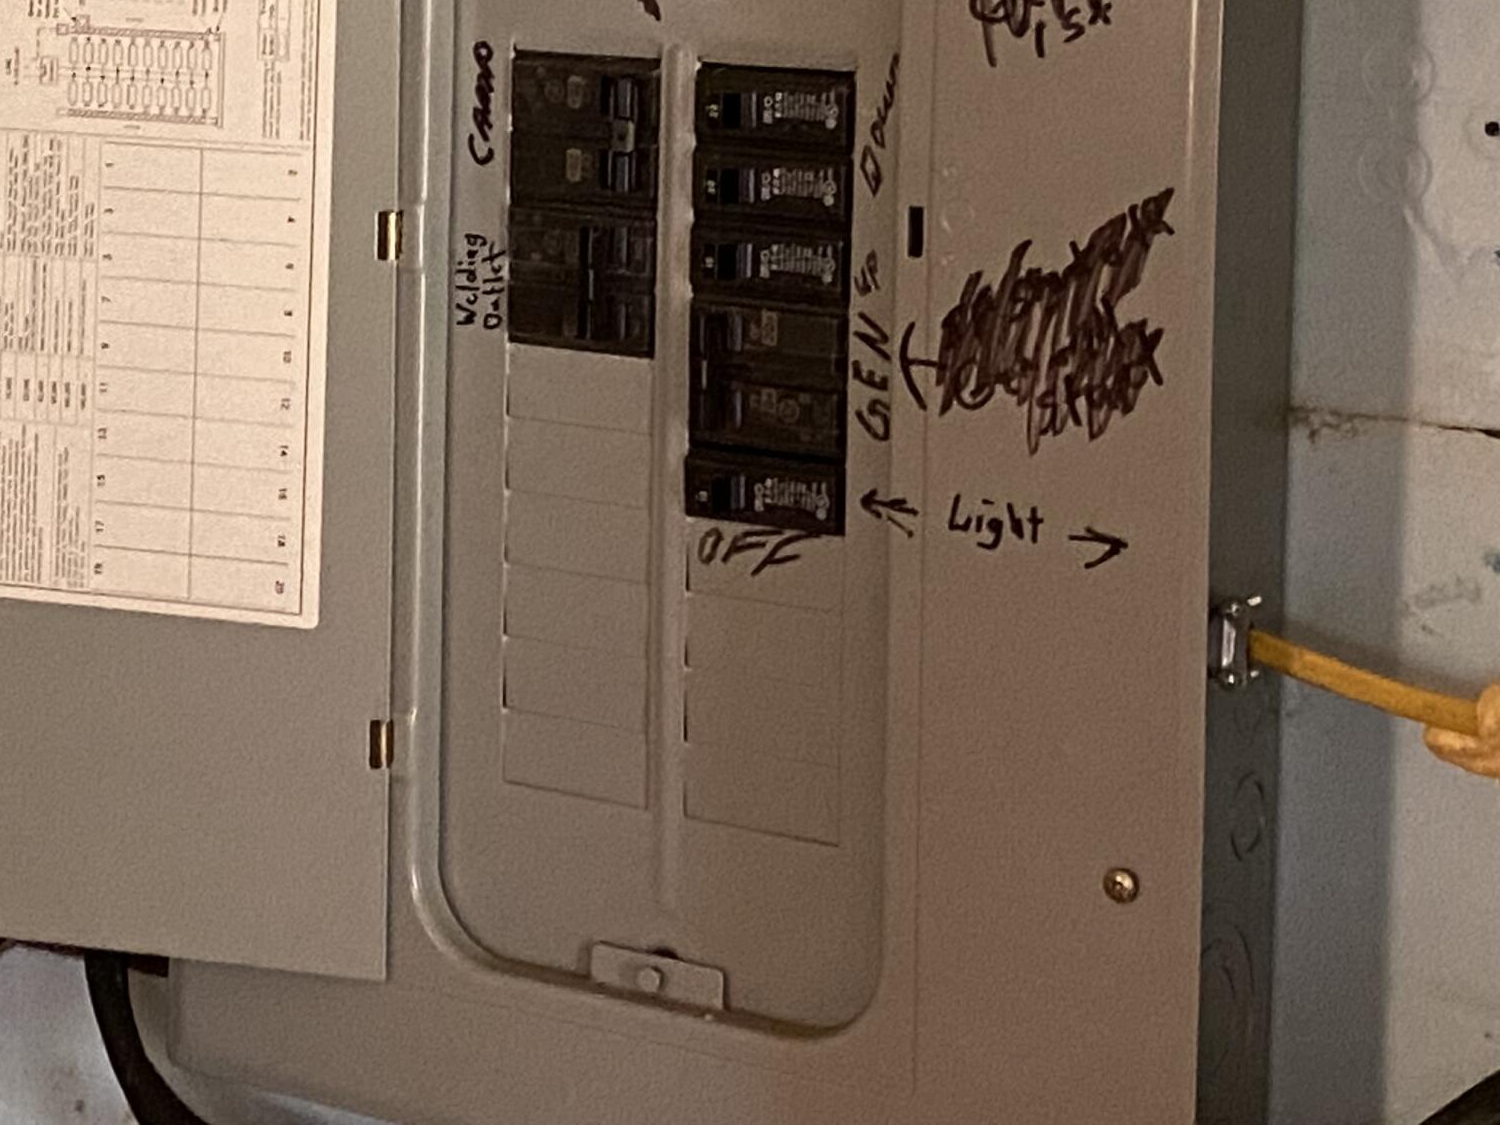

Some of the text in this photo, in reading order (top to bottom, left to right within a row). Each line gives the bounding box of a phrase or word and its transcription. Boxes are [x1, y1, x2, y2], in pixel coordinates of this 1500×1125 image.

[455, 232, 487, 326] Welding
[482, 242, 506, 330] Outlet
[947, 493, 1044, 550] Light
